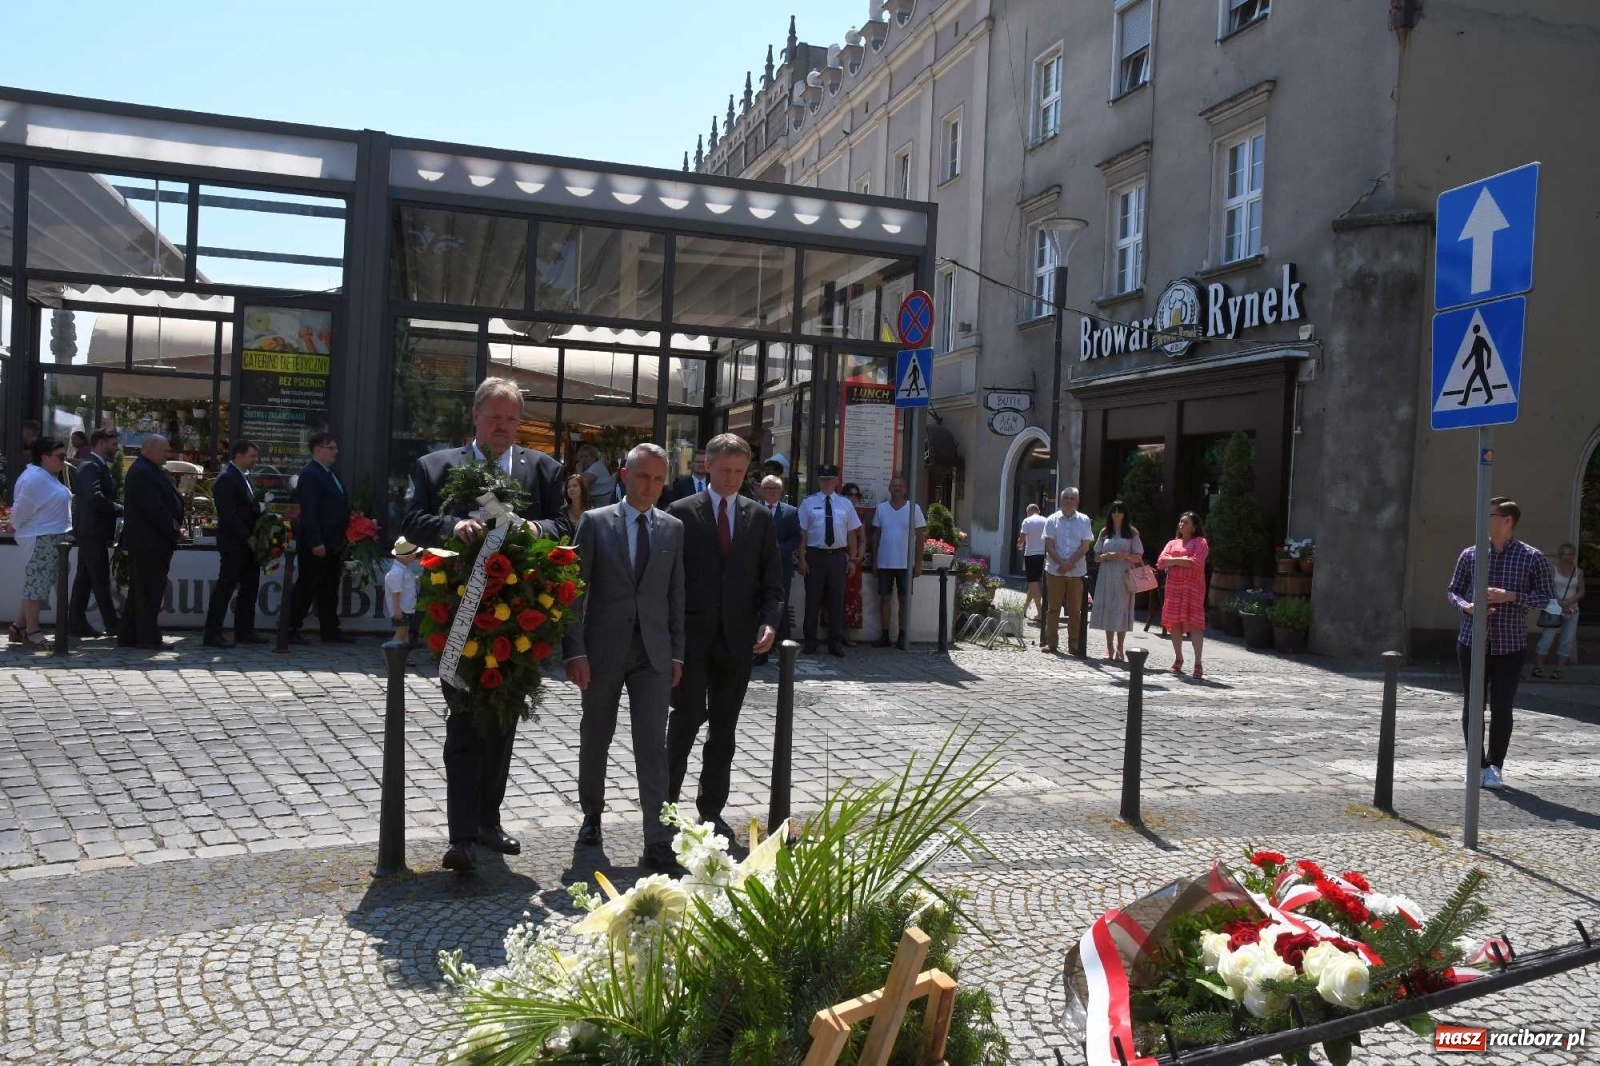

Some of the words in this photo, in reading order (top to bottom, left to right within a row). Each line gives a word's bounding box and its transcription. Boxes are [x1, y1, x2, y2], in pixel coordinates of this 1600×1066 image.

[1080, 316, 1153, 361] Browar
[1207, 263, 1300, 340] Rynek
[243, 353, 278, 370] CATERING
[280, 356, 329, 373] DIETETYCZNY
[278, 376, 292, 386] BEZ
[293, 377, 326, 388] PSZENICY
[853, 387, 890, 399] LUNCH
[997, 396, 1022, 407] BUTIK
